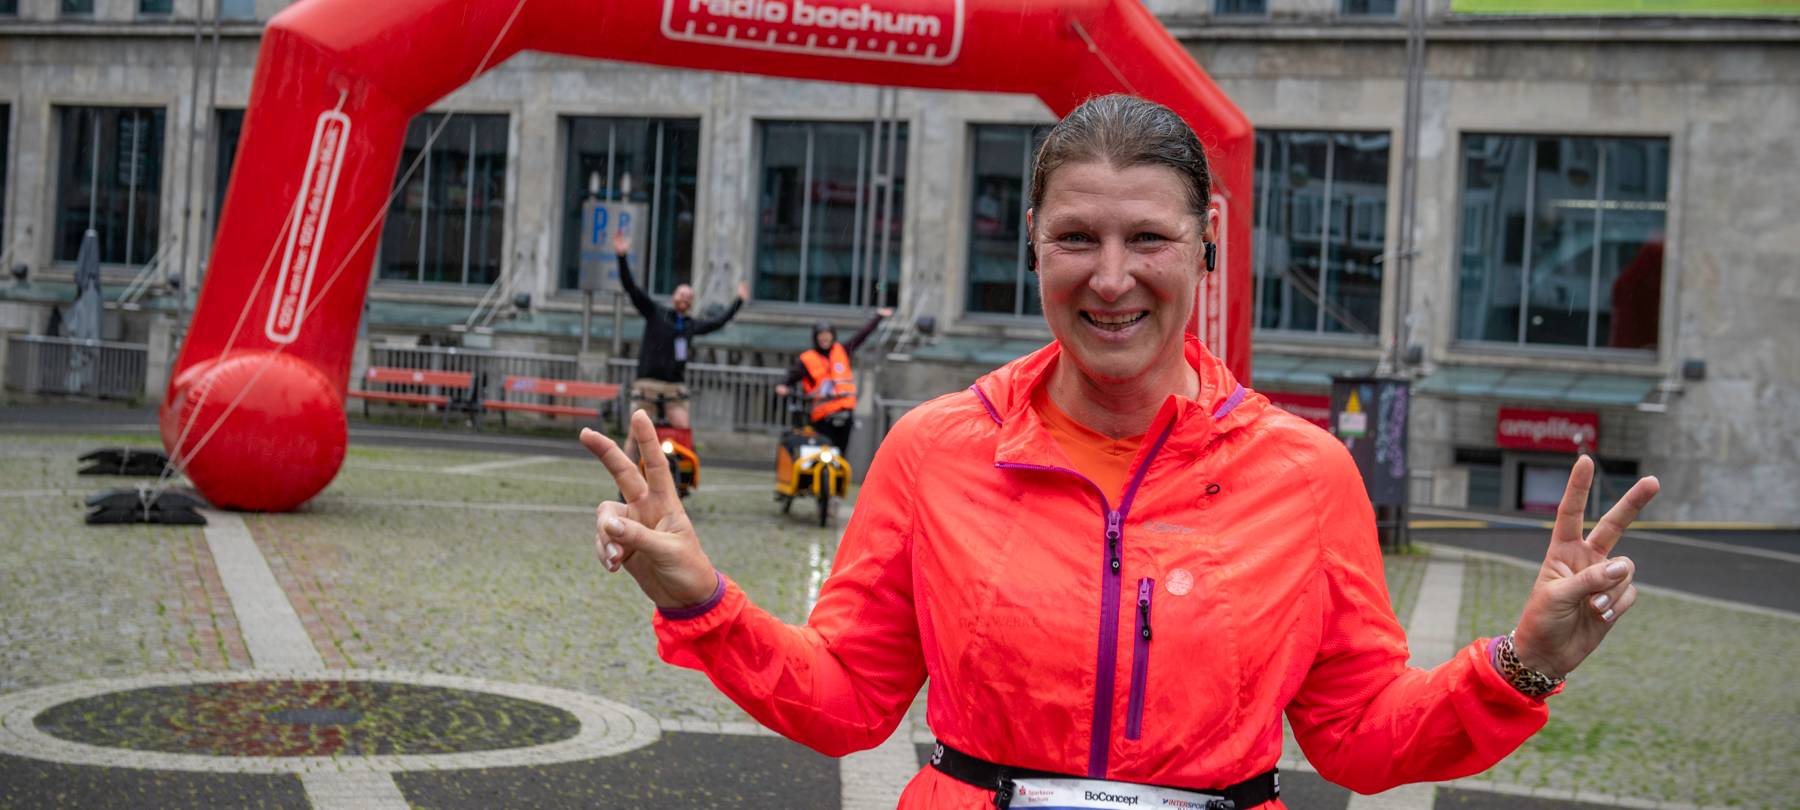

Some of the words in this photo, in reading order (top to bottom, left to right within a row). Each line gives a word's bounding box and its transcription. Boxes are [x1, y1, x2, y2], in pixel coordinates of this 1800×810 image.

[792, 0, 941, 37] bochum
[593, 208, 608, 245] P
[1084, 790, 1139, 806] BoConcept
